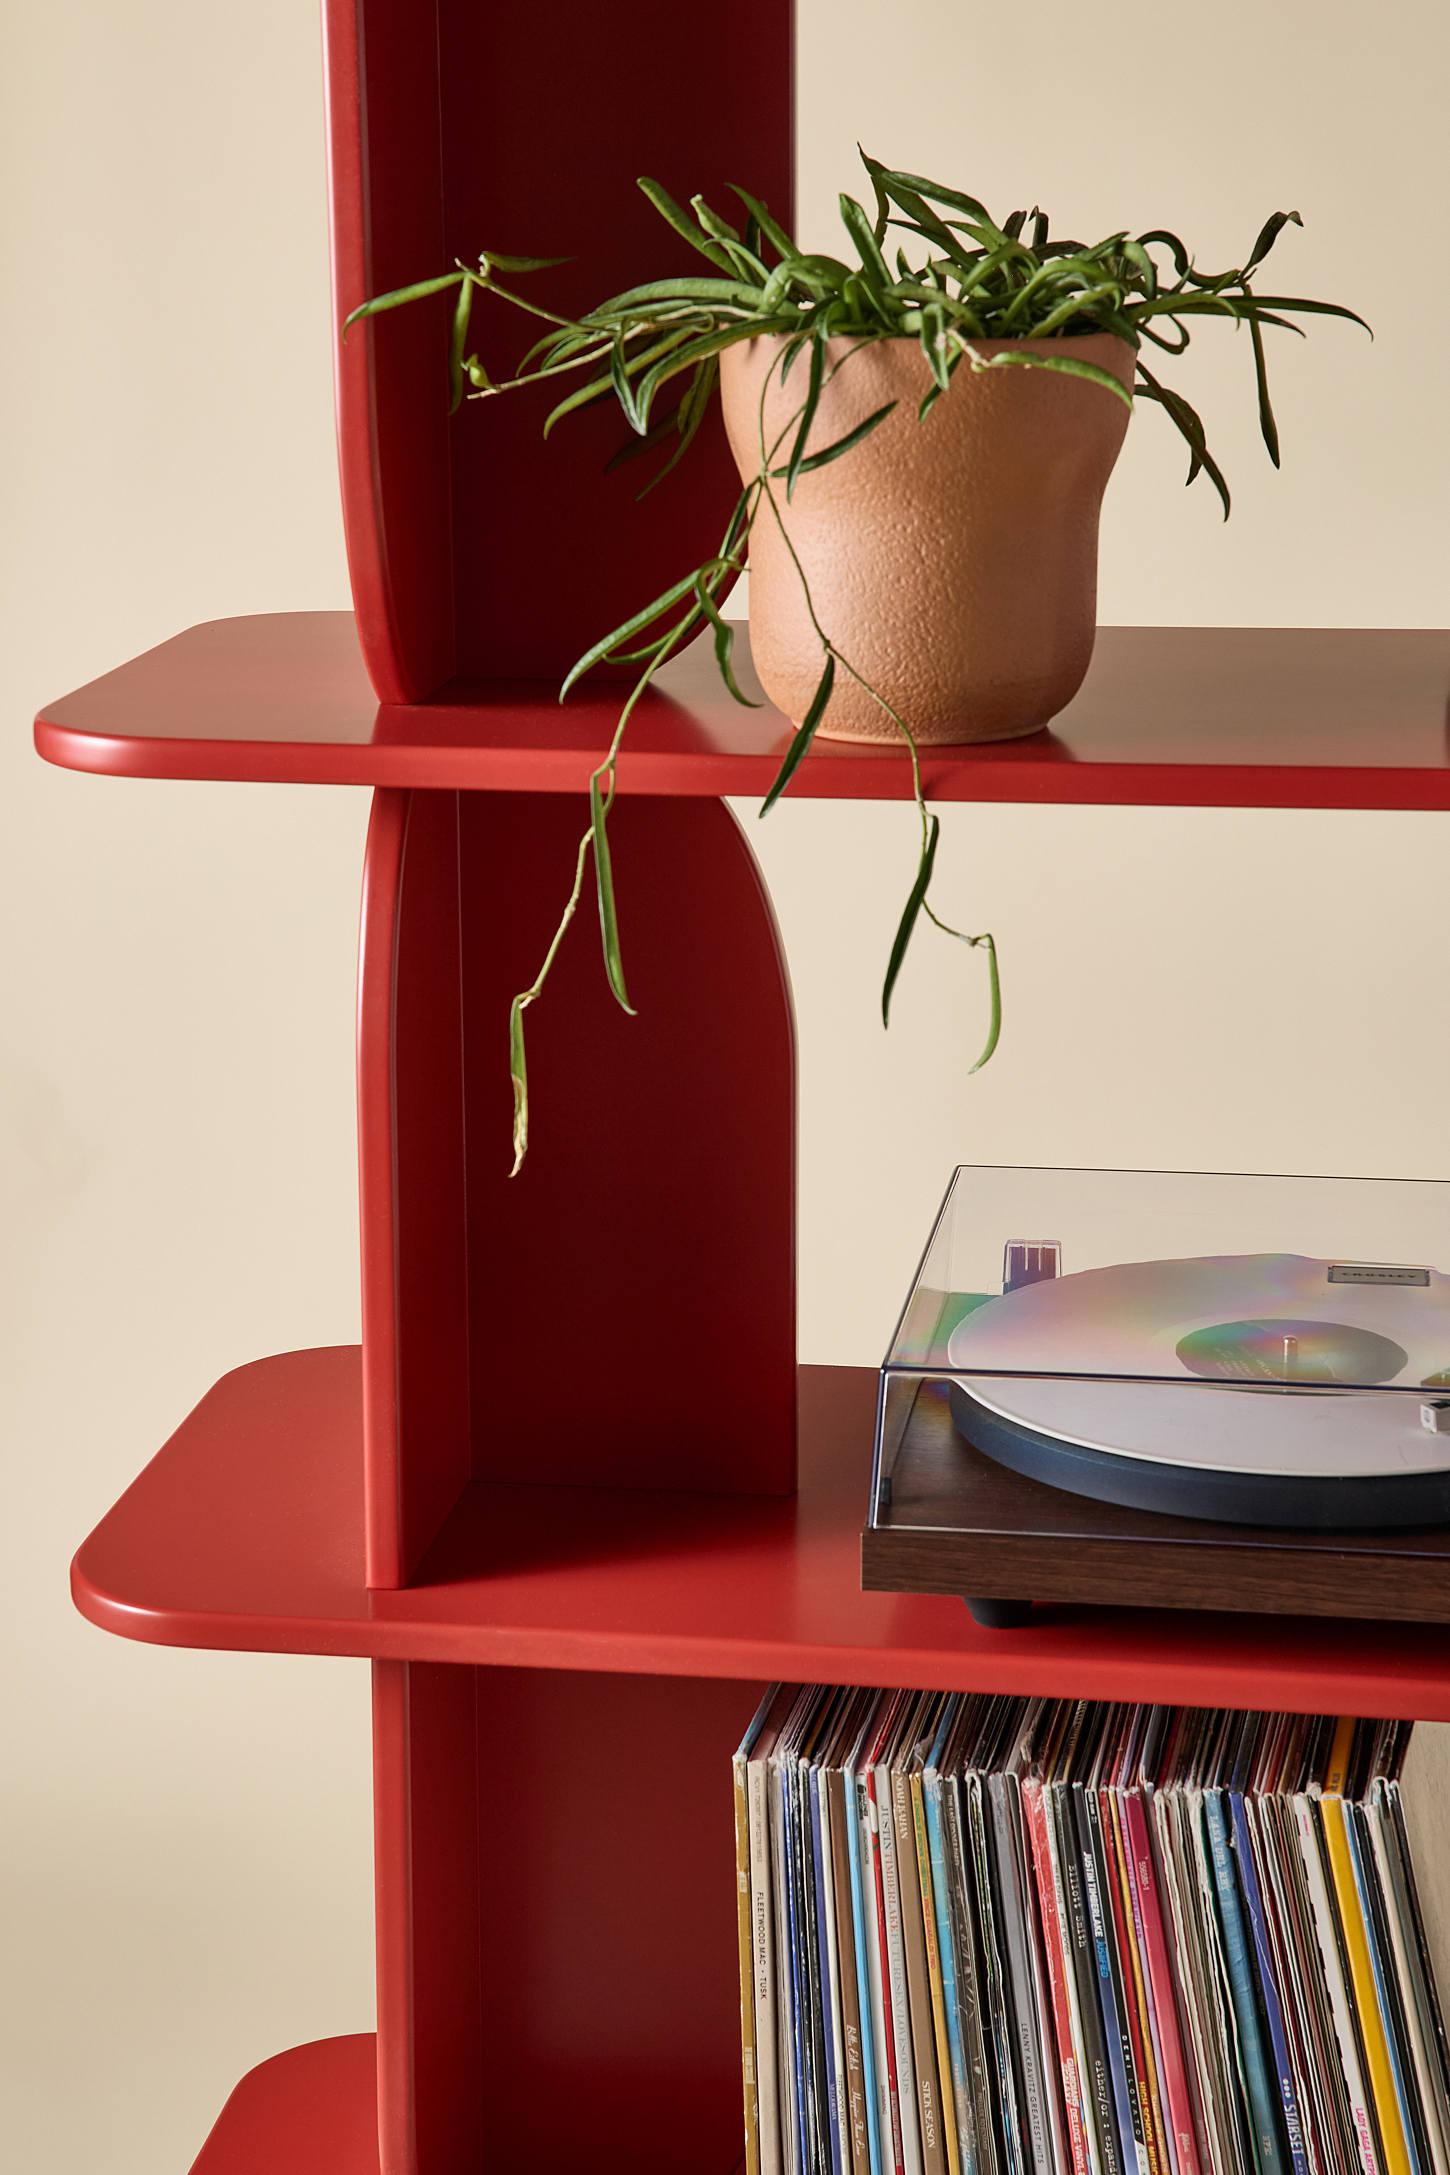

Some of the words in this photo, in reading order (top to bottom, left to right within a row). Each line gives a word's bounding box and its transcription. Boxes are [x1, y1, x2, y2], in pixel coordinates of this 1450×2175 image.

[896, 1776, 906, 1805] NOAH
[880, 1805, 891, 1850] JUSTIN
[897, 1804, 908, 1839] KAHAN
[948, 1807, 956, 1822] LAST
[1209, 1816, 1220, 1843] LANA
[1083, 1851, 1098, 1882] JUSTIN
[1214, 1847, 1225, 1867] DEL
[884, 1852, 898, 1933] TIMBERLAKE
[1068, 1864, 1082, 1909] Elliott
[1075, 1915, 1087, 1948] Smith
[1087, 1882, 1104, 1937] TIMBERLAKE
[756, 1892, 765, 1944] FLEETWOOD
[758, 1947, 766, 1966] MAC
[1096, 1938, 1110, 1977] JUSTIFIED
[759, 1977, 767, 2000] TUSK
[1020, 2023, 1032, 2053] LENNY
[1024, 2056, 1036, 2093] KRAVITZ
[1095, 2059, 1110, 2117] either/or
[1121, 2035, 1132, 2070] DEMI
[1127, 2078, 1142, 2136] LOVATO
[921, 2081, 934, 2109] STICK
[1139, 2081, 1148, 2105] HIGH
[924, 2109, 936, 2149] SEASON
[1029, 2096, 1042, 2141] GREATEST
[1070, 2108, 1081, 2144] DELUXE
[1142, 2107, 1153, 2142] SCHOOL
[1284, 2104, 1304, 2154] STARSET
[1355, 2107, 1366, 2128] LADY
[1036, 2144, 1045, 2165] HITS
[1359, 2130, 1370, 2151] GAGA
